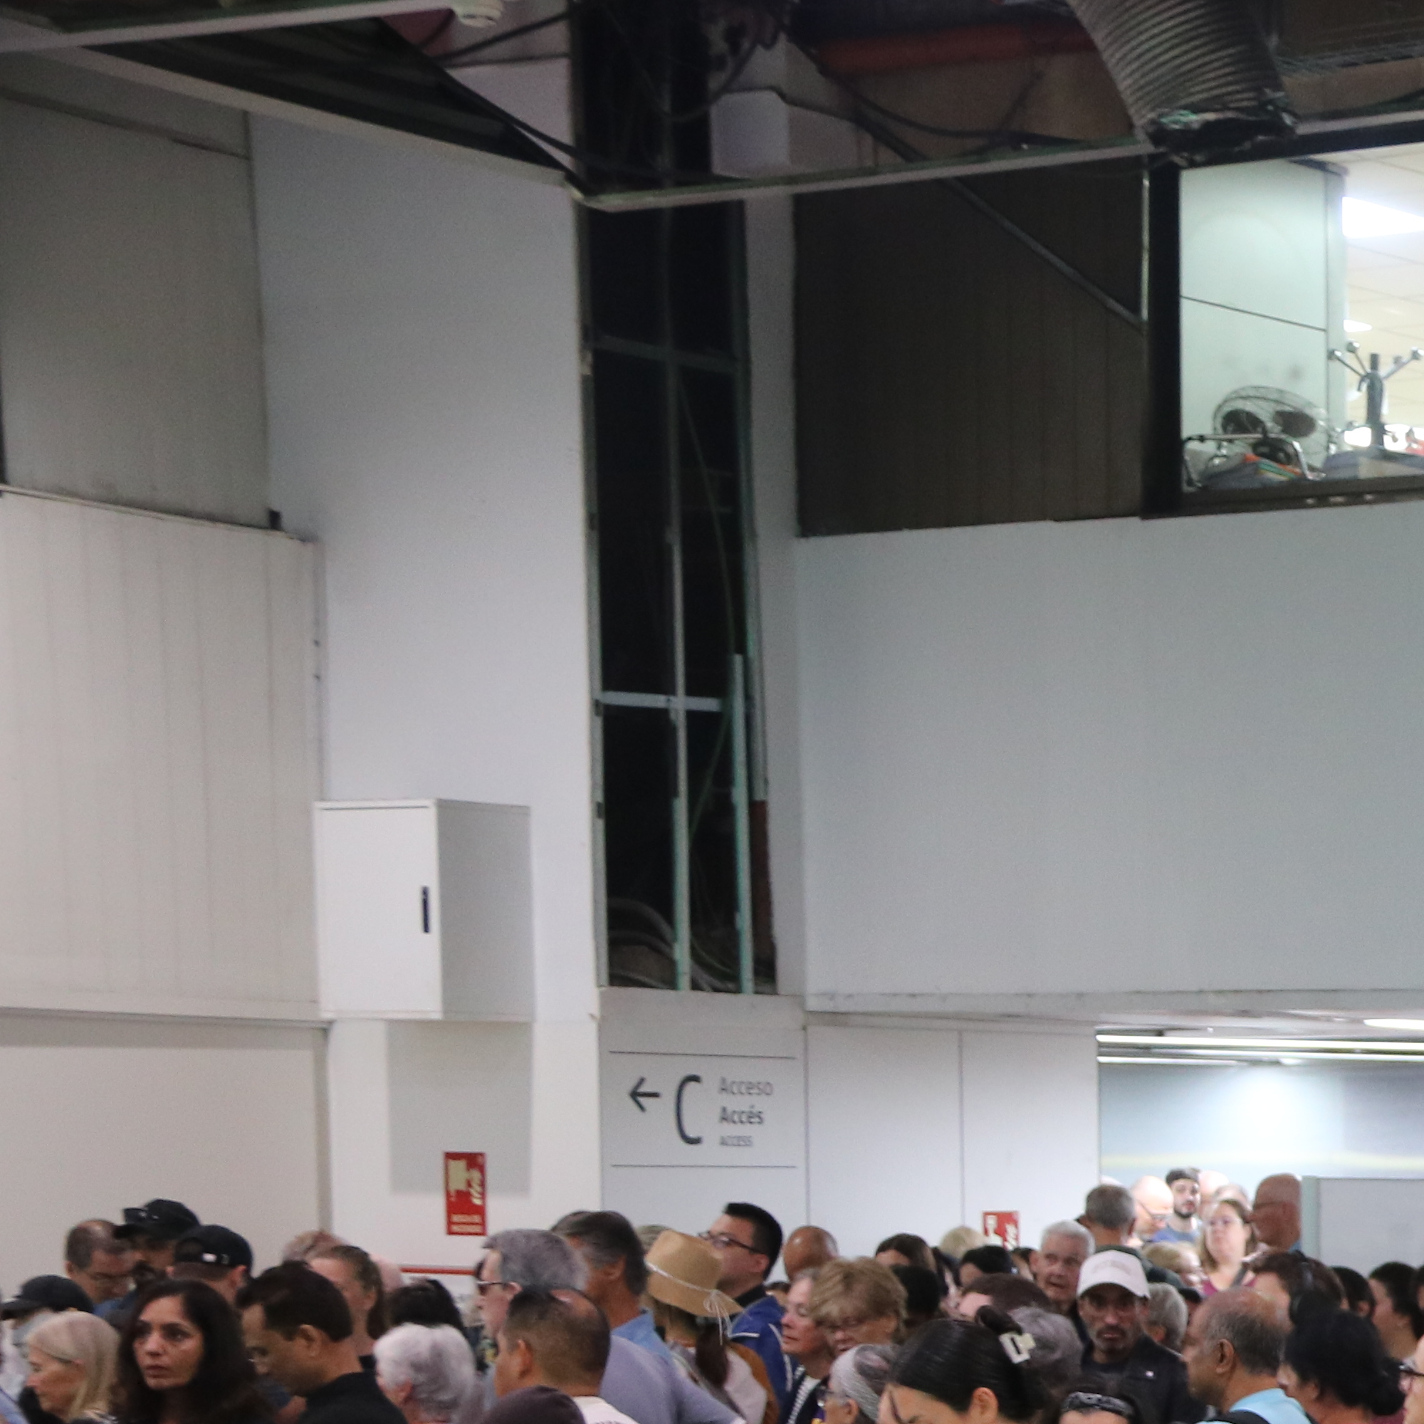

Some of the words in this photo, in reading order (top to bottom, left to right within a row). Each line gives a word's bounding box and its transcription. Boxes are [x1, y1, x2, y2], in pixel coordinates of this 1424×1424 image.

[719, 1076, 773, 1096] Acceso
[675, 1073, 703, 1145] C
[719, 1104, 764, 1125] Accés
